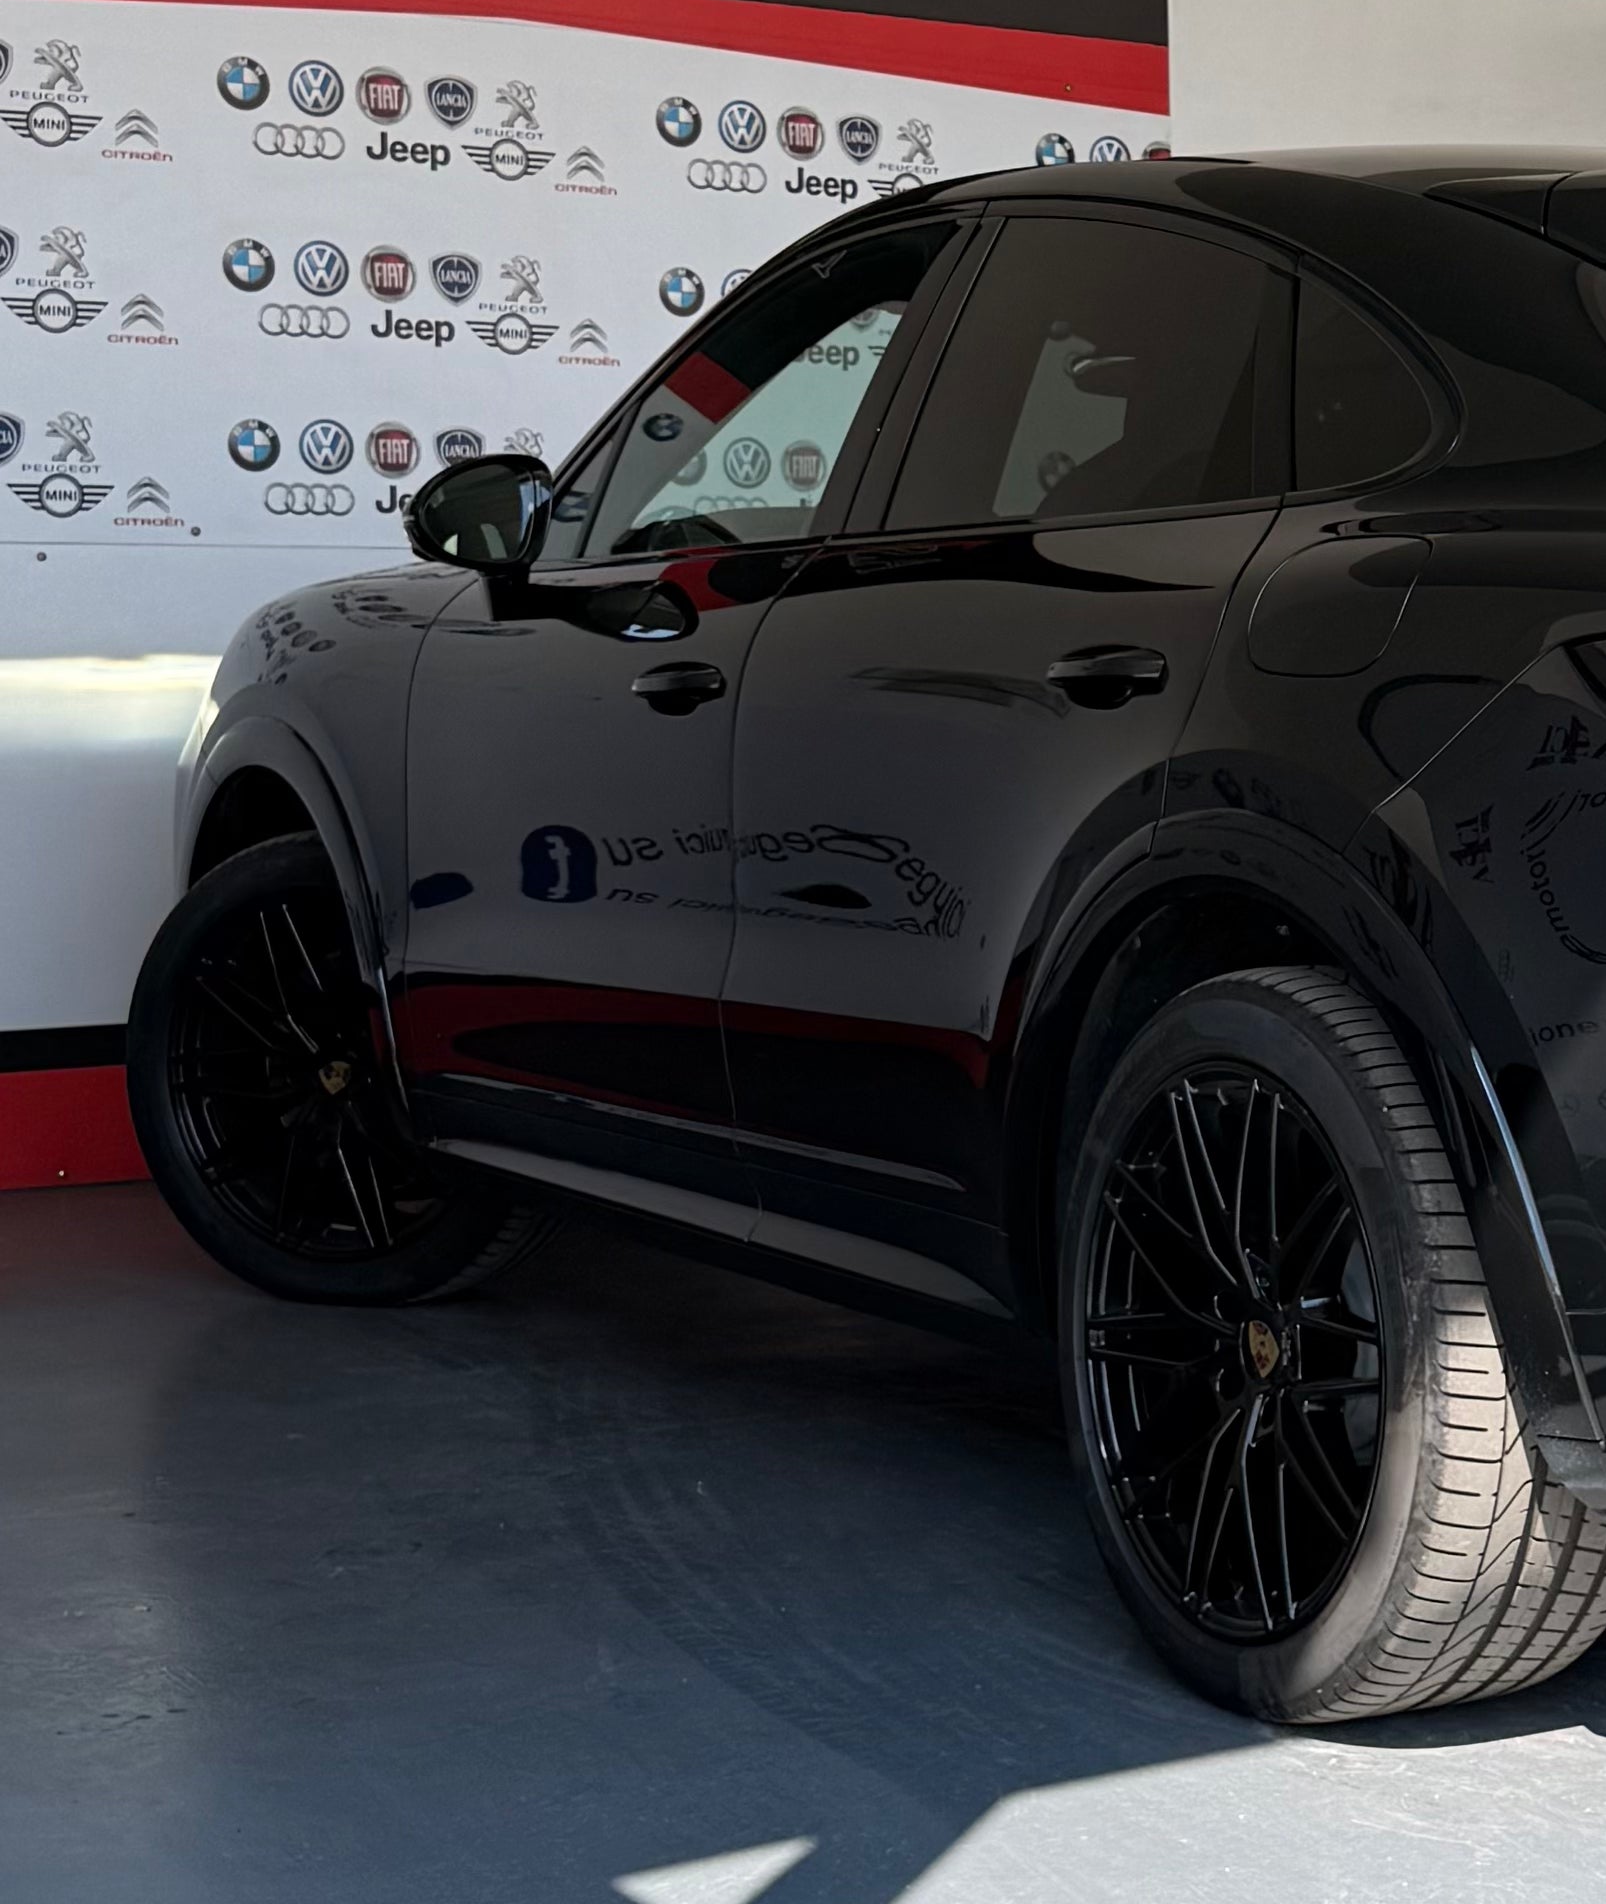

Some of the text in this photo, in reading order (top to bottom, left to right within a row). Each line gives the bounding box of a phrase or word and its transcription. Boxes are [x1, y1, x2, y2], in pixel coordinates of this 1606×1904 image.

[9, 89, 90, 103] PEUGEOT
[369, 83, 401, 110] FIAT
[33, 117, 66, 131] MINI
[474, 127, 545, 141] PEUGEOT
[788, 121, 816, 147] FIAT
[366, 131, 451, 171] Jeep
[495, 155, 524, 166] MINI
[878, 162, 939, 175] PEUGEOT
[785, 167, 858, 204] Jeep
[374, 262, 405, 288] FIAT
[16, 278, 96, 289] PEUGEOT
[39, 305, 71, 317] MINI
[479, 303, 548, 315] PEUGEOT
[371, 309, 455, 347] Jeep
[499, 327, 528, 339] MINI
[794, 344, 859, 371] eep
[379, 438, 410, 464] FIAT
[22, 463, 101, 474] PEUGEOT
[45, 490, 77, 501] MINI
